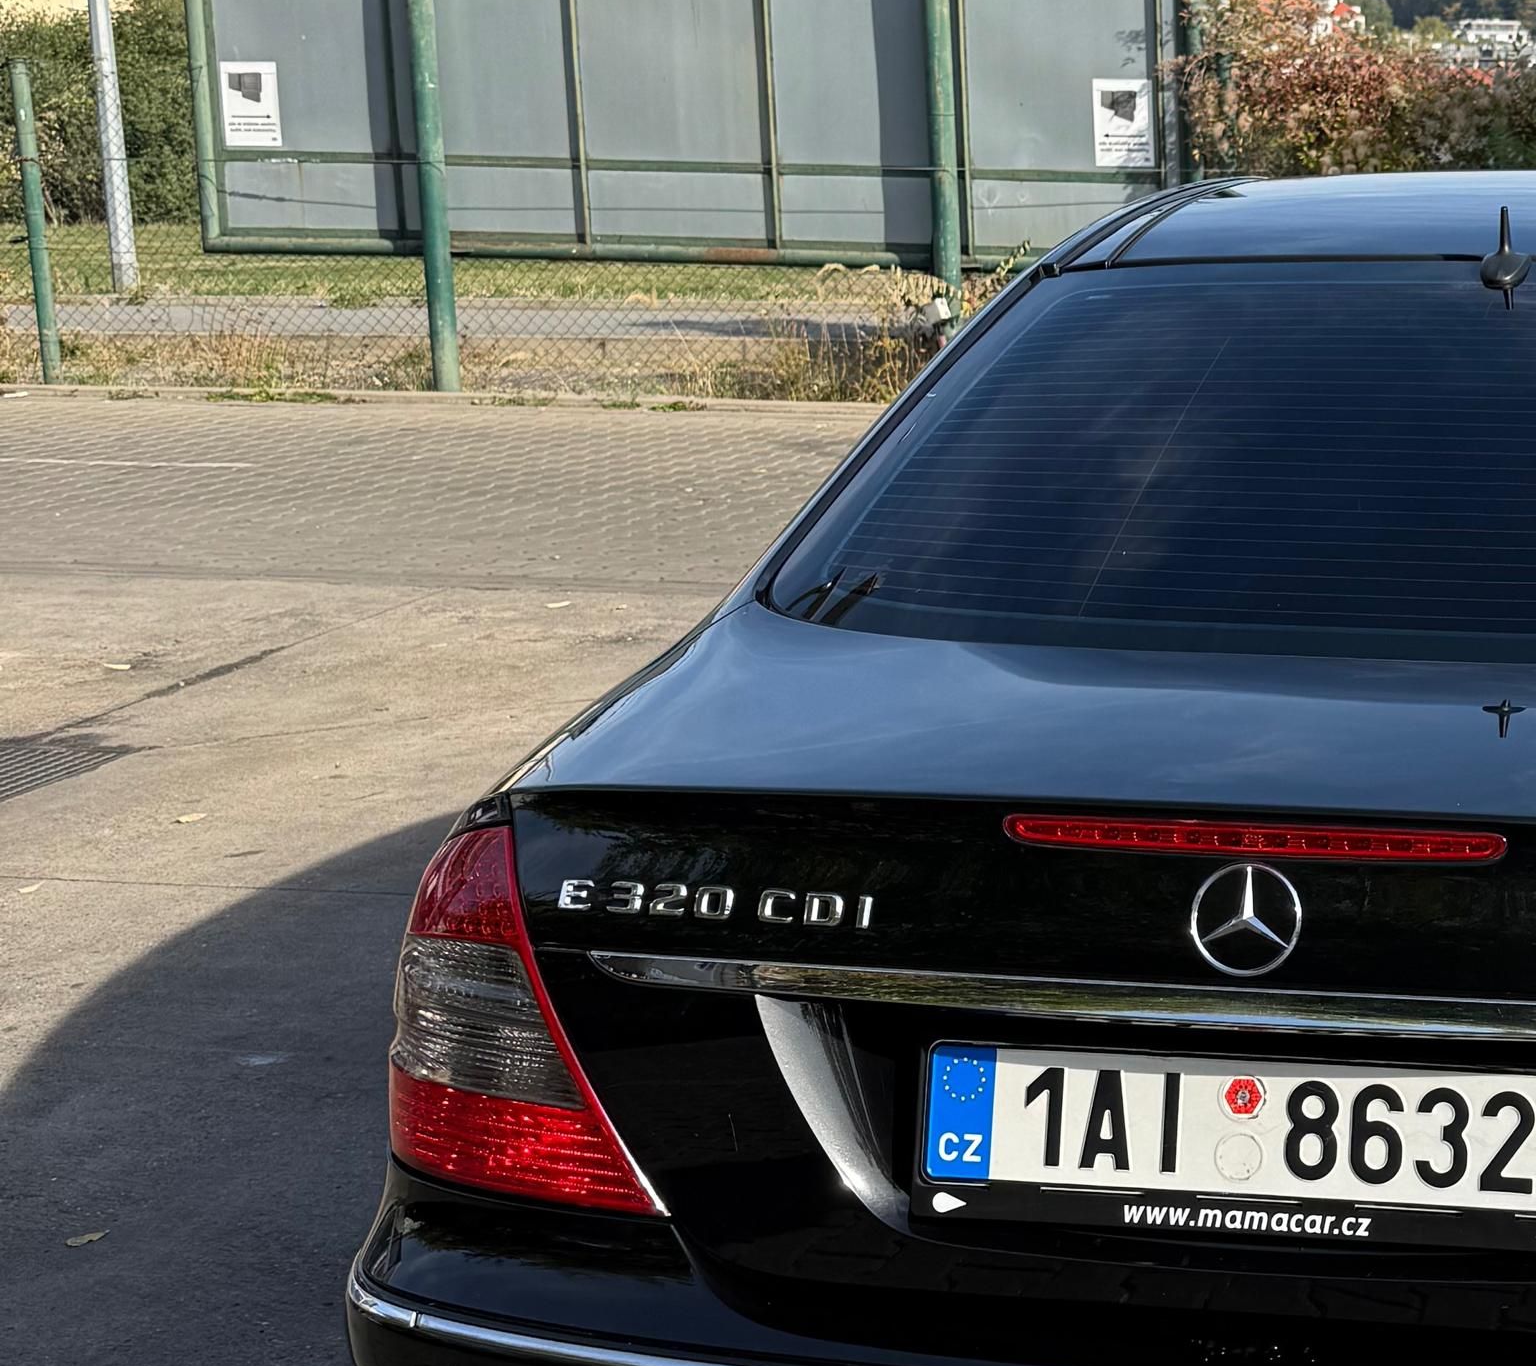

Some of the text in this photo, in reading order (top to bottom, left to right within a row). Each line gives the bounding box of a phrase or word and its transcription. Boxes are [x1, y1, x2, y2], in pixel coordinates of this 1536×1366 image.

[557, 879, 873, 929] E 320 CDI
[937, 1131, 983, 1164] CZ
[1025, 1066, 1536, 1195] 1AI 8632
[1123, 1203, 1373, 1237] www.mamacar.cz
